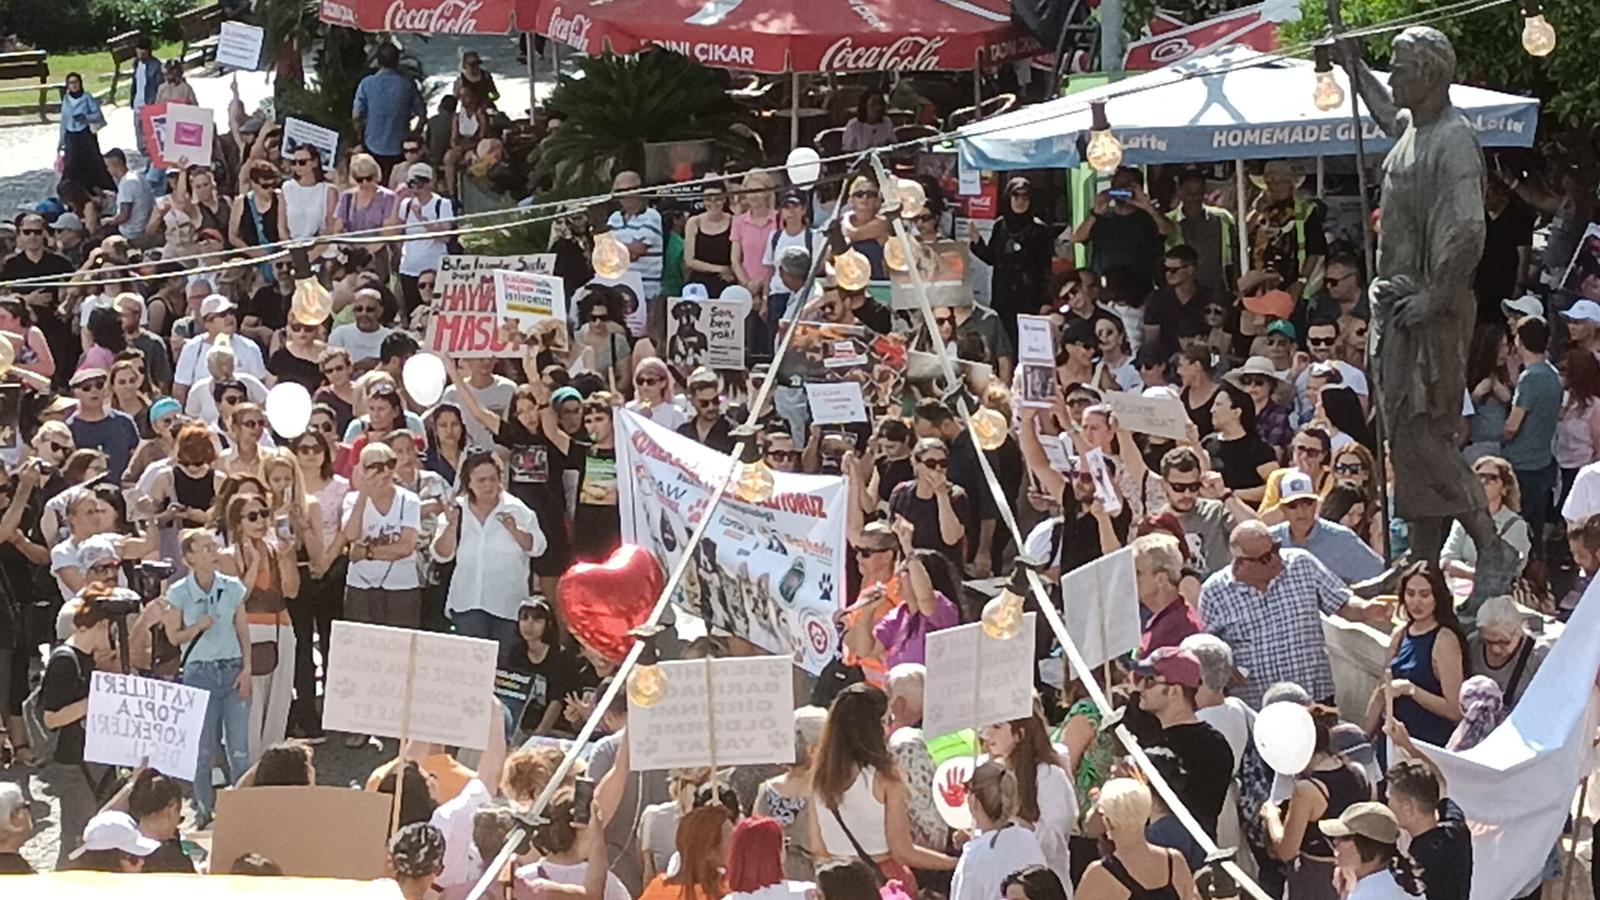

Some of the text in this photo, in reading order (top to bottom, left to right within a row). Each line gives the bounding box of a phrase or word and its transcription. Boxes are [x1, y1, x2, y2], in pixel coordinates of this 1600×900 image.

[694, 42, 754, 65] ÇIKAR
[819, 36, 948, 71] Coca-Cola
[1212, 124, 1331, 149] HOMEMADE
